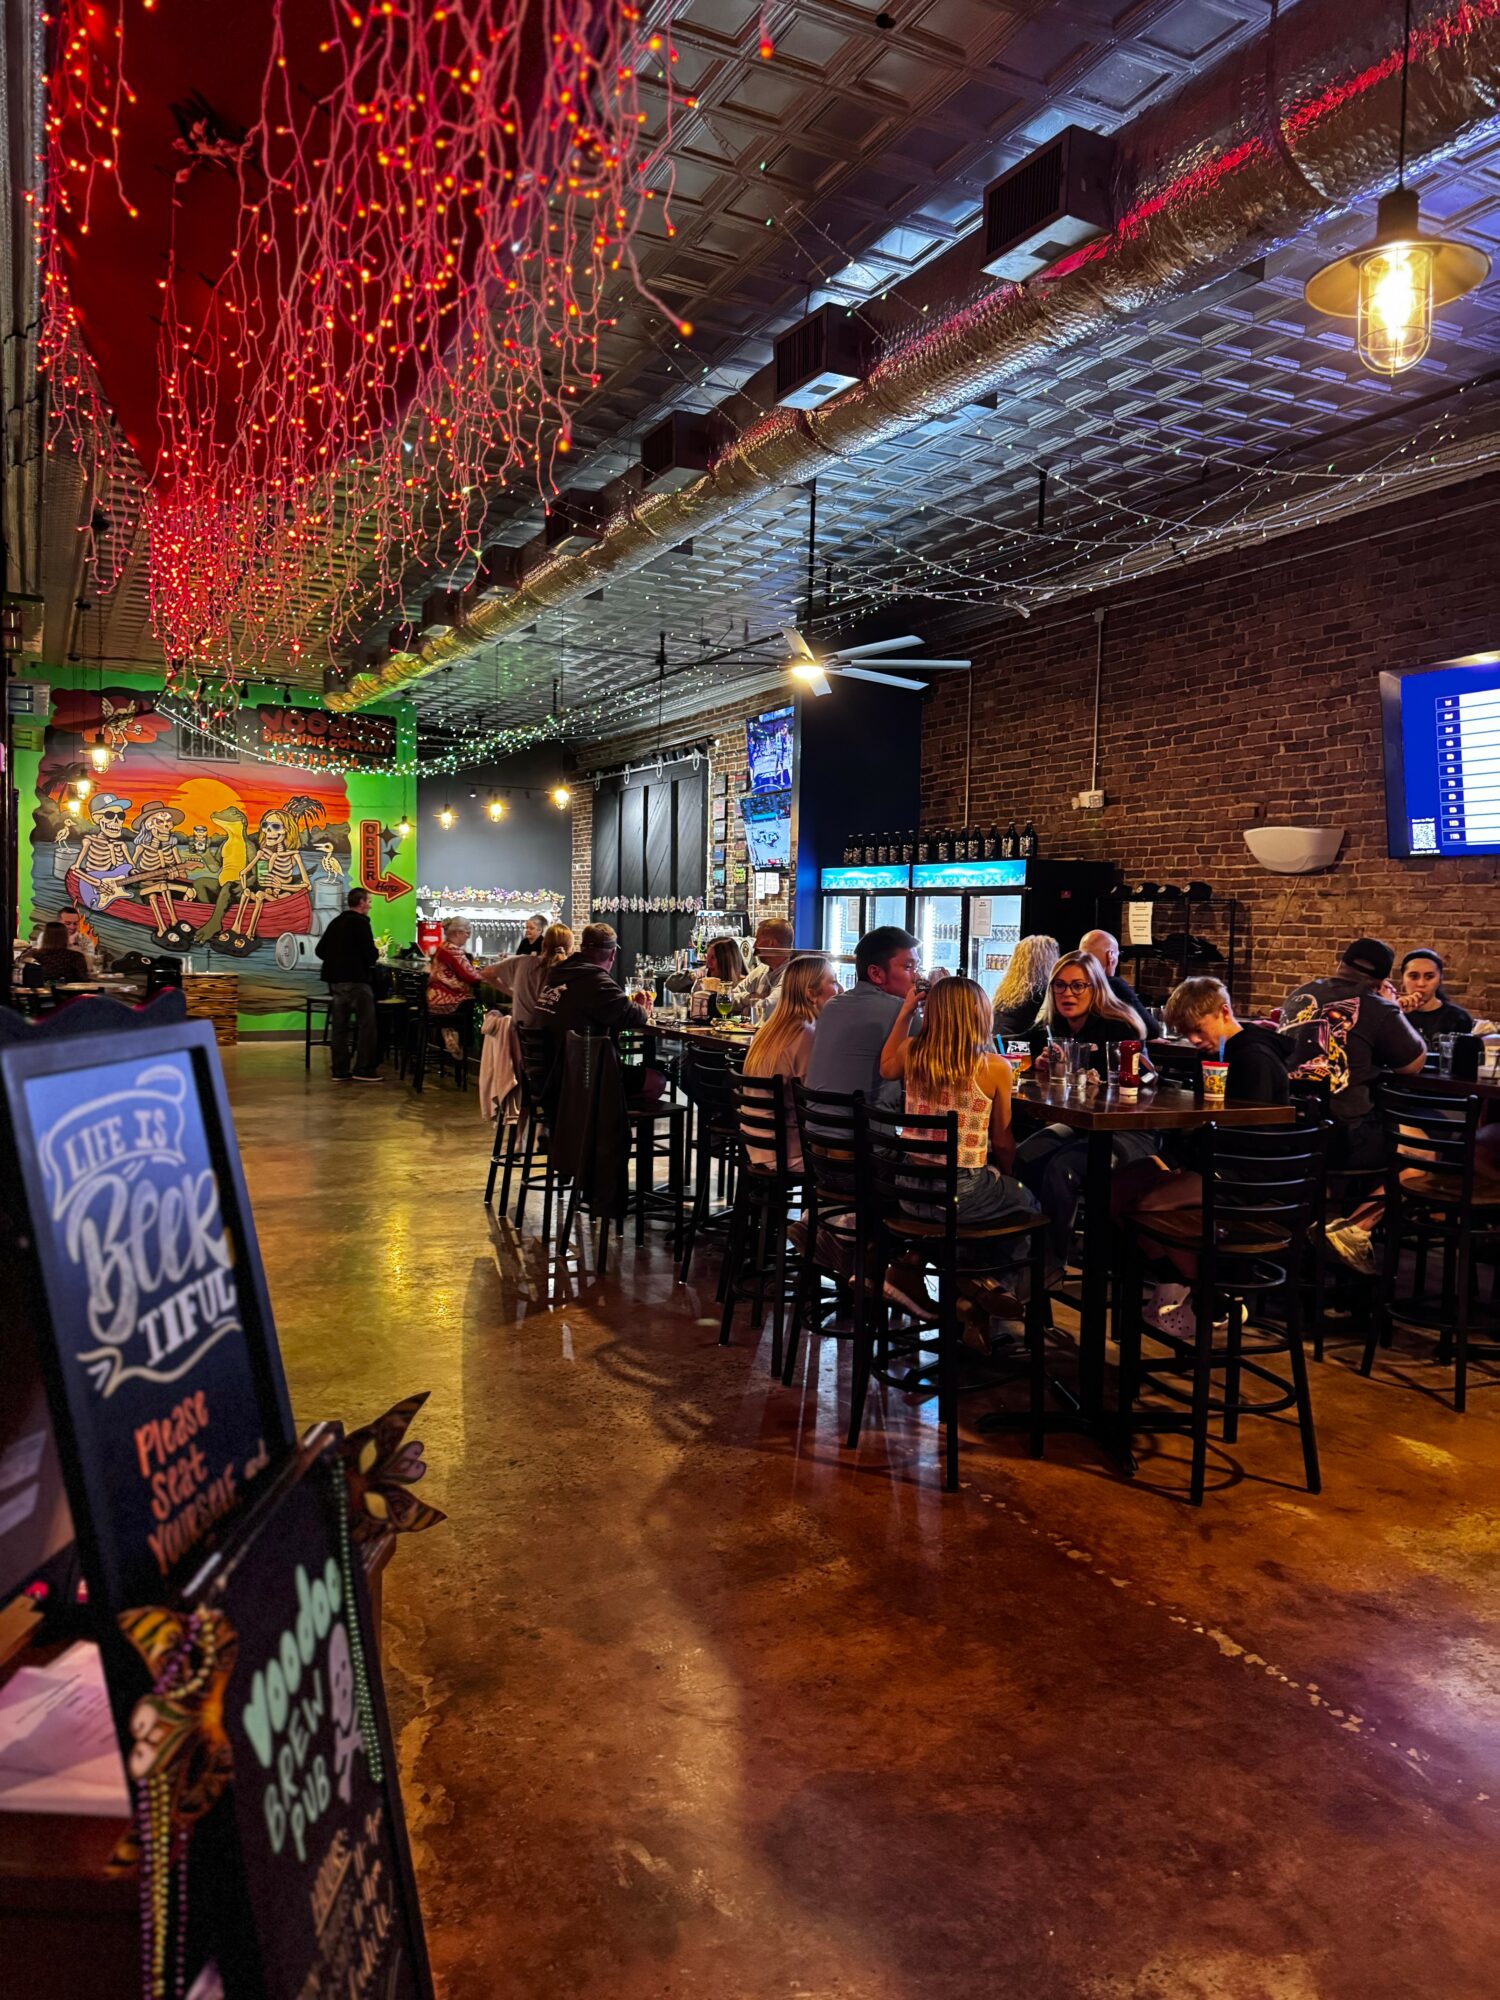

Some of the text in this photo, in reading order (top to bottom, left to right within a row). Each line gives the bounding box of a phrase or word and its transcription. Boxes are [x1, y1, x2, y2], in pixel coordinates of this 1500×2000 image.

[365, 824, 376, 881] ORDER
[64, 1108, 168, 1179] LIFE IS
[138, 1265, 237, 1367] TIFUL
[134, 1389, 210, 1479] Please
[264, 1668, 324, 1855] BREW
[291, 1755, 331, 1863] PUB
